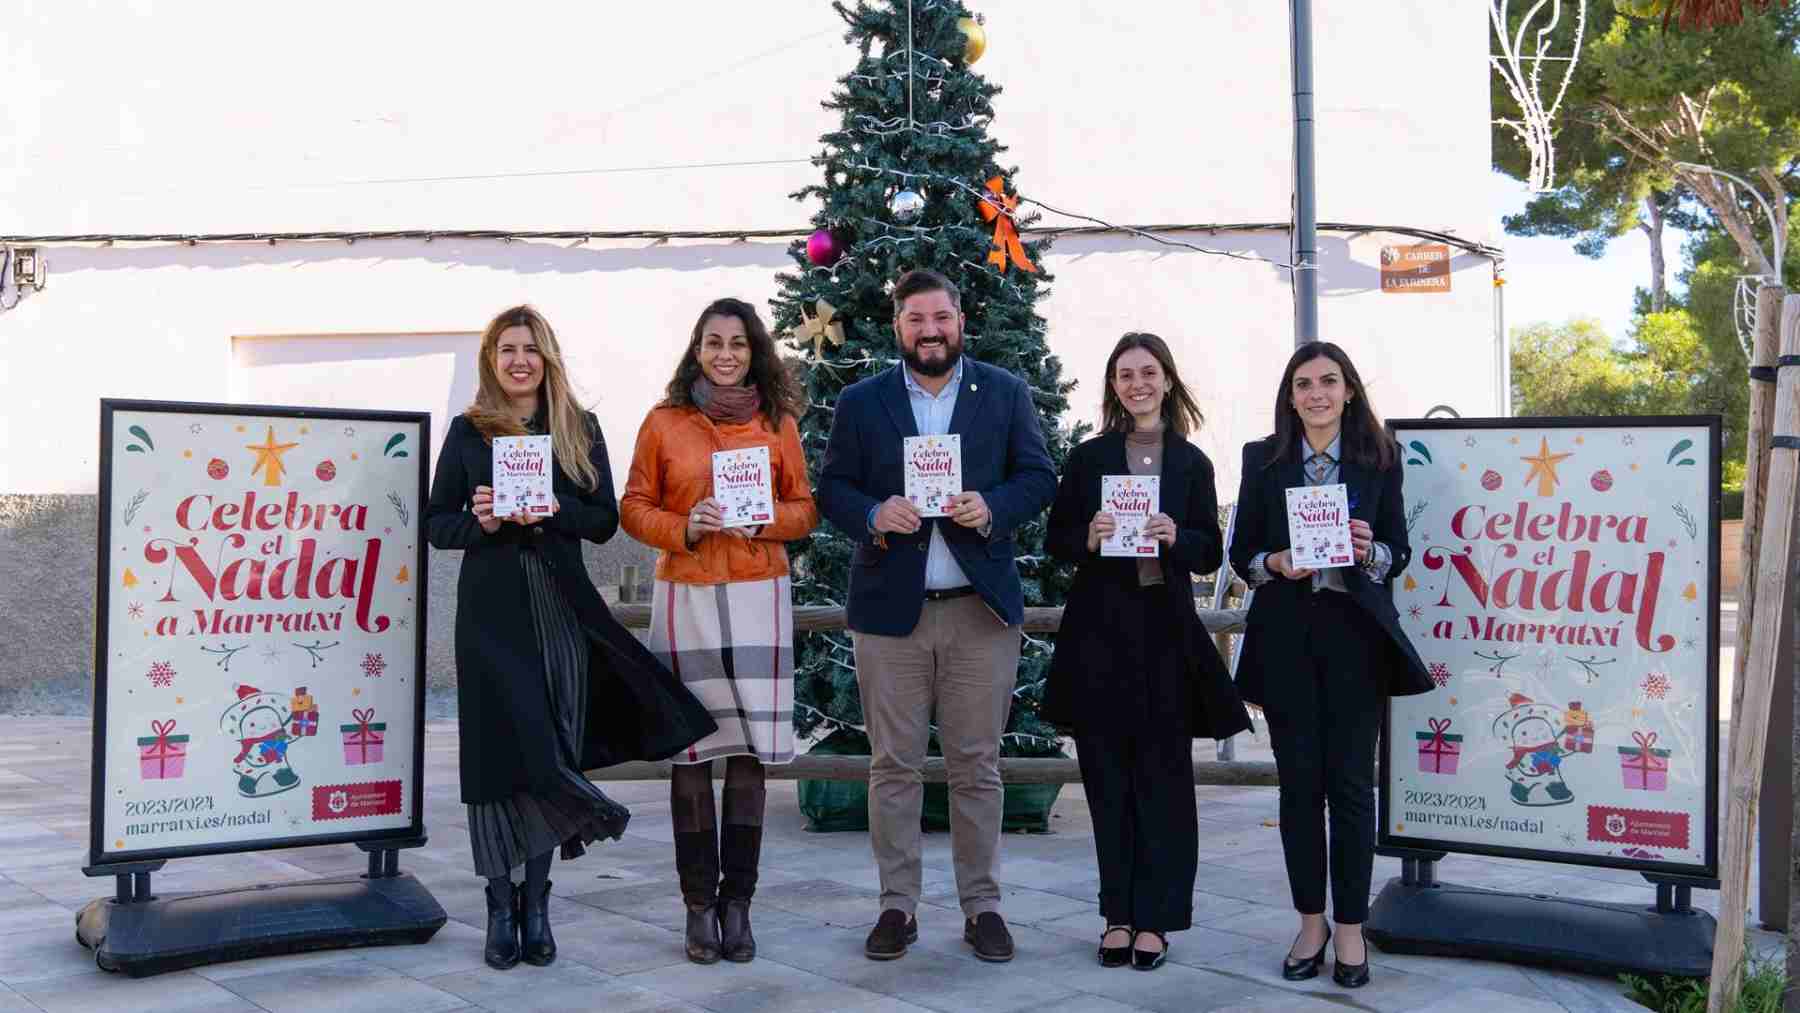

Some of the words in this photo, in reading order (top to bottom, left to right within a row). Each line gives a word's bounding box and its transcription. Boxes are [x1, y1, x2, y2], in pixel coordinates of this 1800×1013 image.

[498, 457, 545, 476] Nadal
[908, 457, 955, 476] Nadal
[717, 468, 764, 487] Nadal
[176, 491, 368, 531] Celebra
[1106, 498, 1152, 517] Nadal
[1293, 508, 1343, 527] Nadal
[1451, 501, 1649, 543] Celebra
[261, 535, 283, 555] el
[1532, 545, 1555, 566] el
[144, 533, 390, 633] Nadal
[1422, 543, 1676, 653] Nadal
[156, 615, 178, 636] a
[189, 604, 346, 636] Marratxí
[1432, 620, 1453, 640] a
[1461, 616, 1624, 647] Marratxí
[125, 795, 215, 816] 2023/2024
[1404, 790, 1487, 811] 2023/2024
[125, 809, 271, 836] marratxi.es/nadal
[1405, 810, 1544, 834] marratxi.es/nadal
